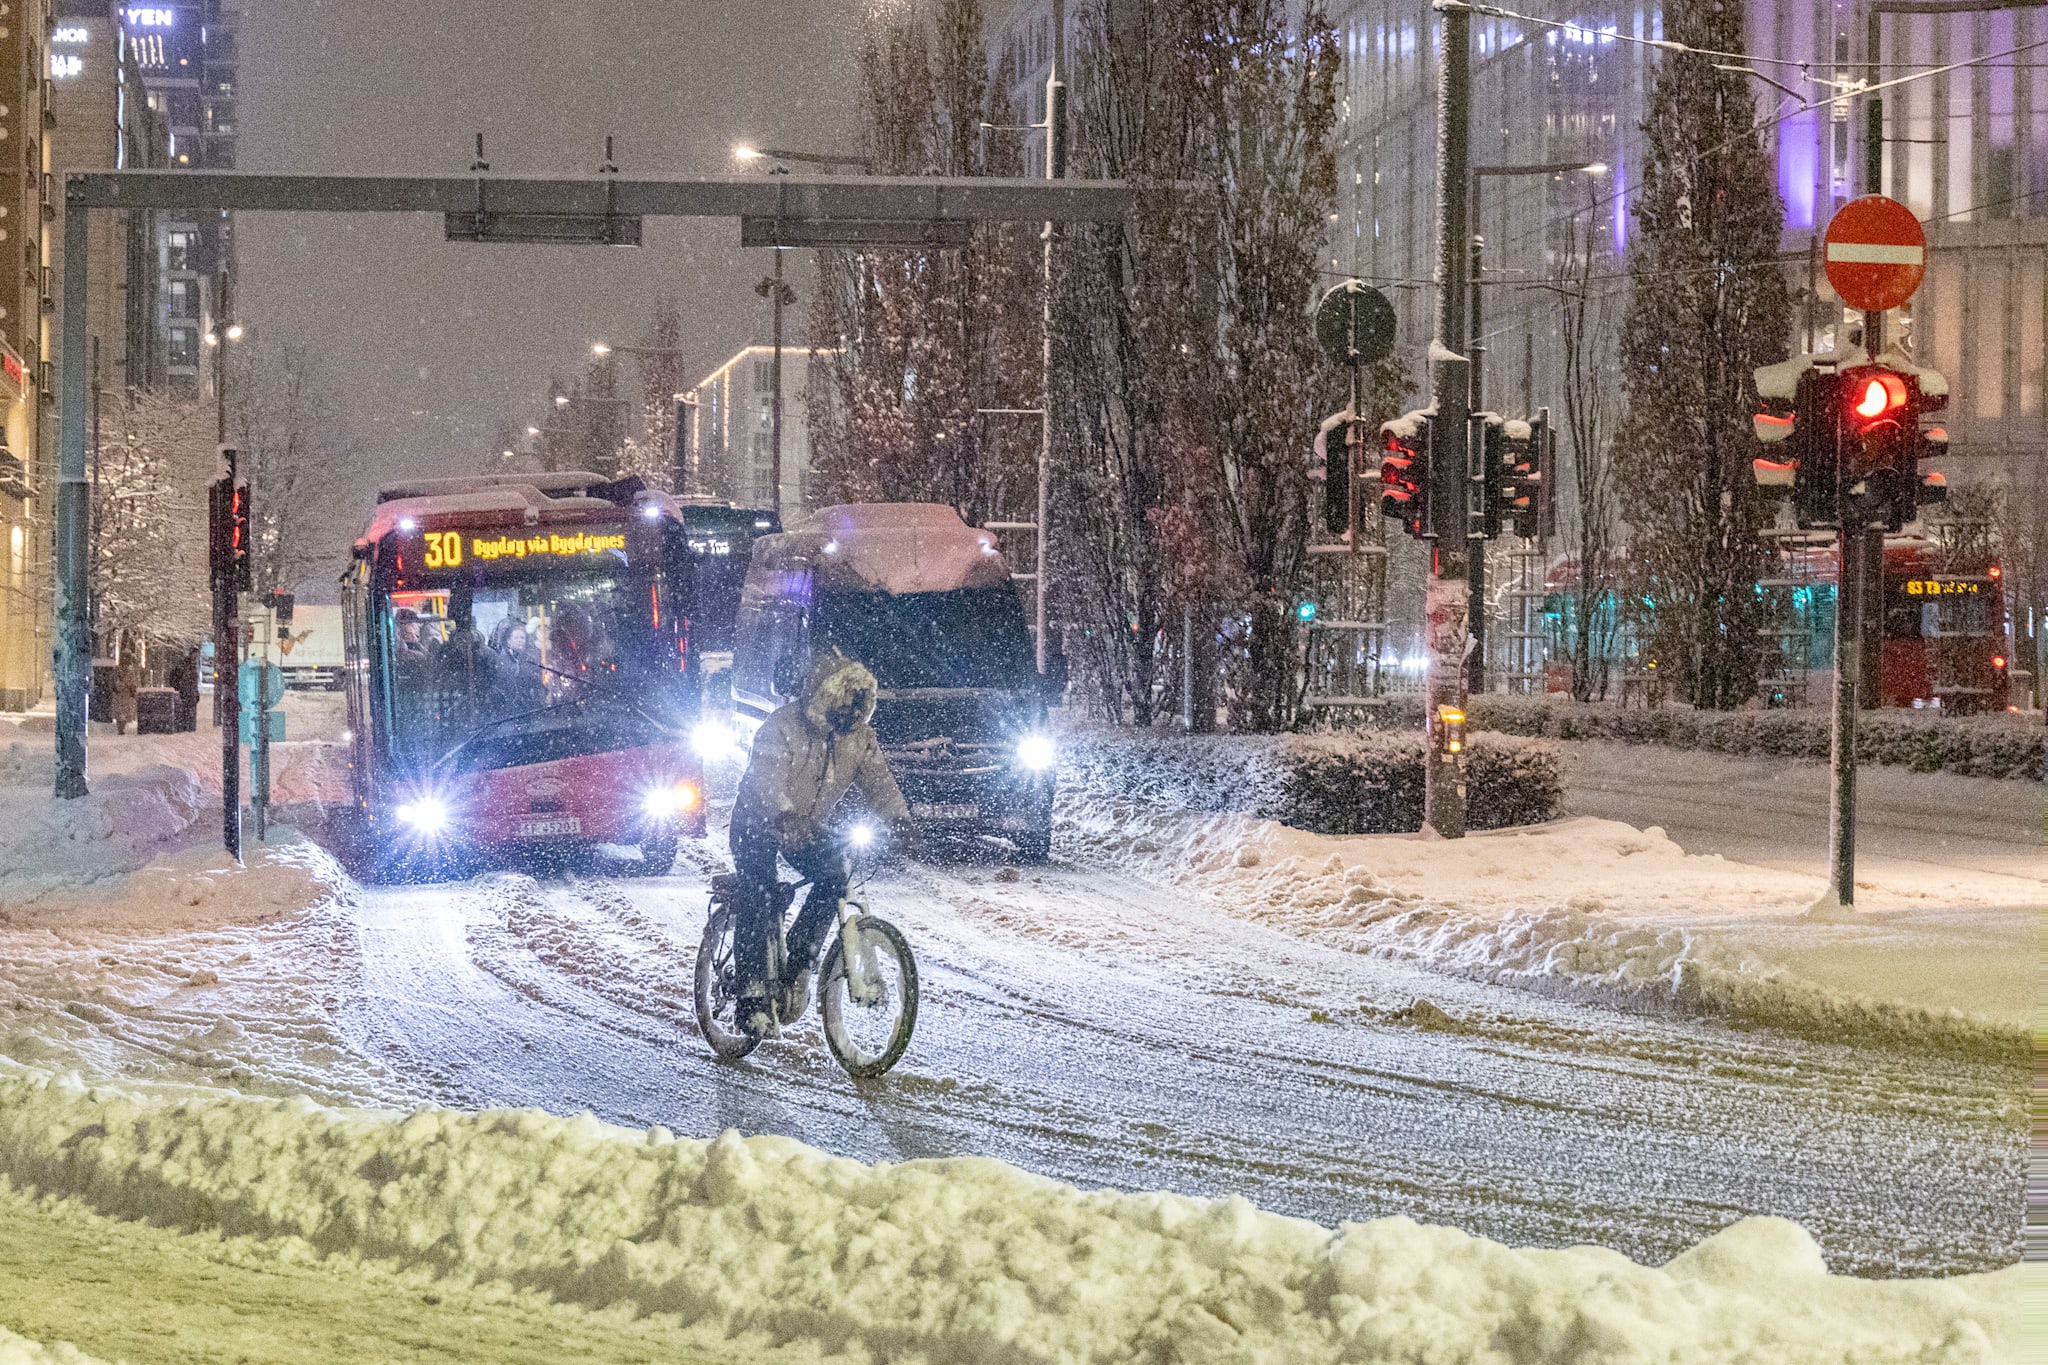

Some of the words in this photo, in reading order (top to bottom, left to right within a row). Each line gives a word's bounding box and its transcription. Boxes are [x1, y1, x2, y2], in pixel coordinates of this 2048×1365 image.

[423, 531, 463, 568] 30
[472, 535, 526, 559] Bygdøy
[527, 536, 549, 553] via
[550, 532, 625, 555] Bygdøynes
